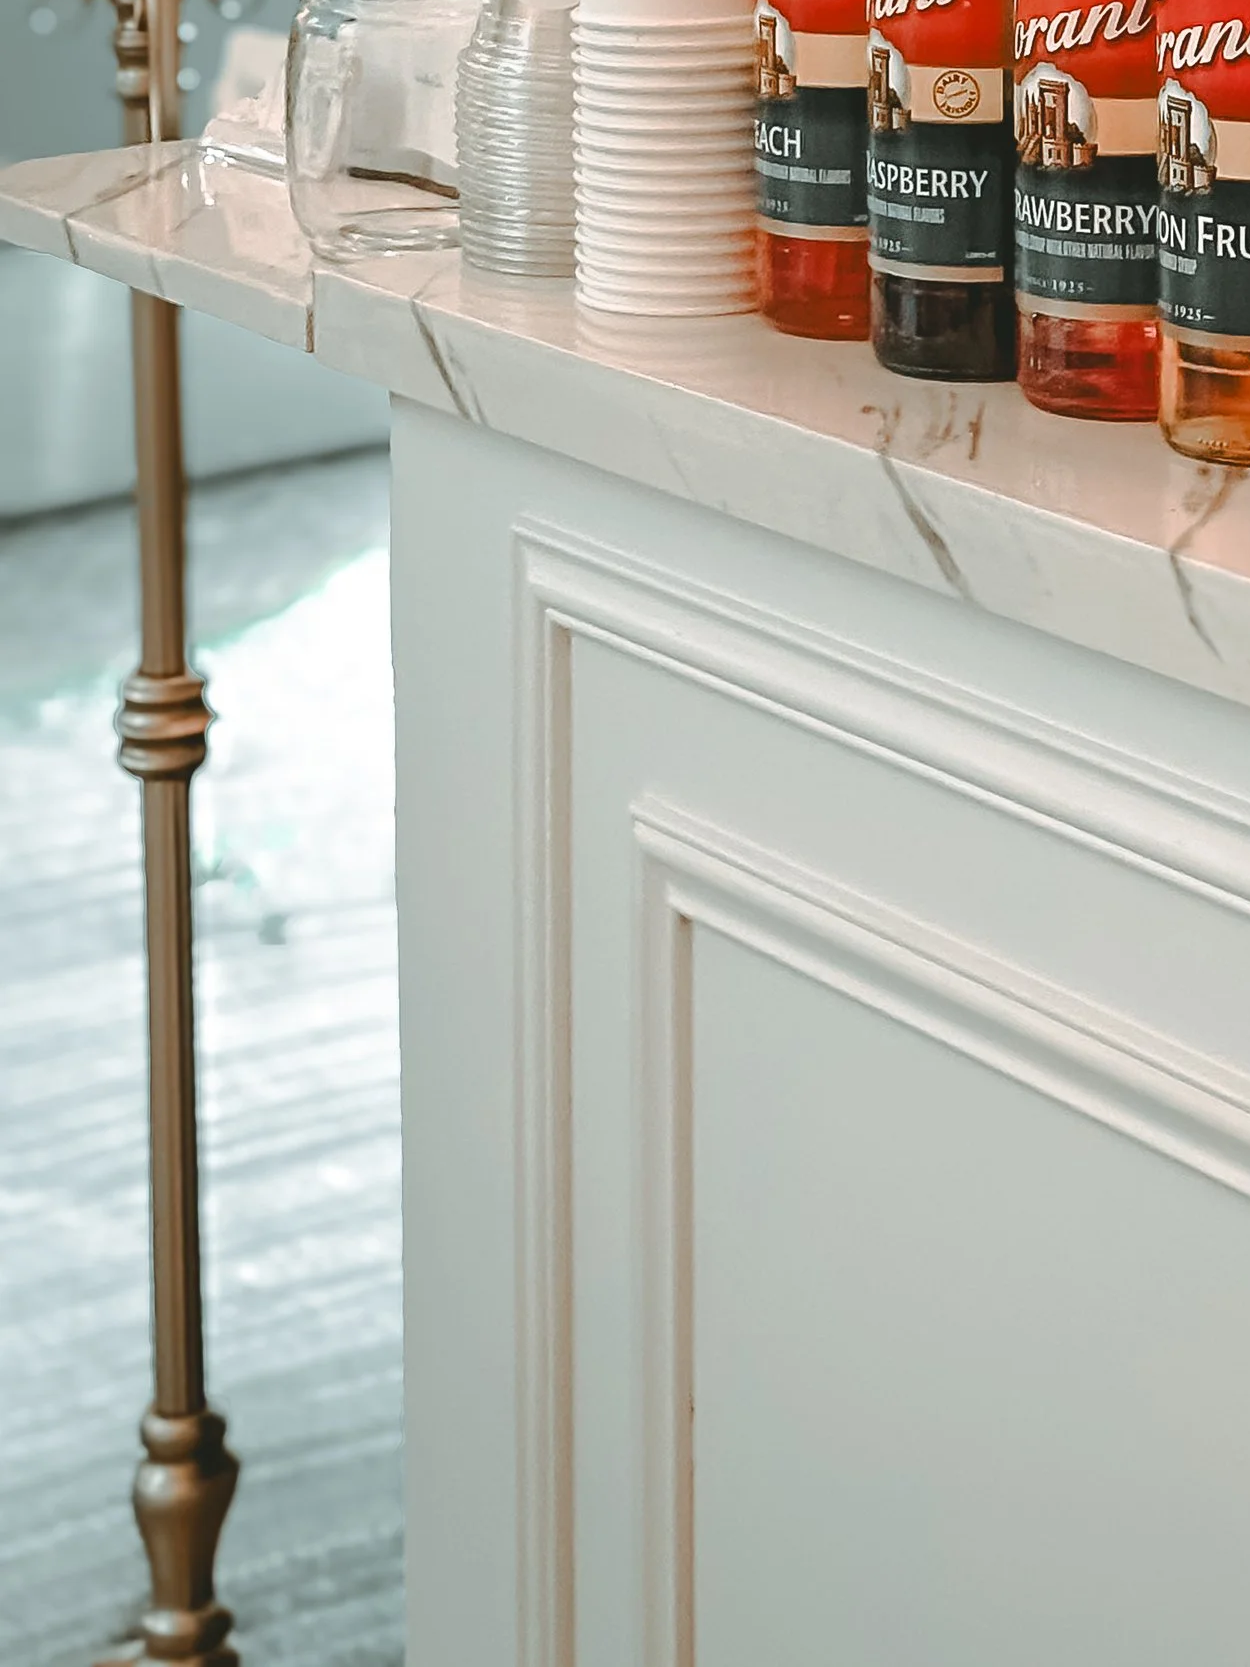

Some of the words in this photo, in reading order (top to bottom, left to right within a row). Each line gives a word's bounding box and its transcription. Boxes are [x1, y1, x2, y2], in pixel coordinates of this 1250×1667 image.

[754, 119, 801, 159] EACH
[1014, 187, 1156, 235] RAWBERRY
[1174, 304, 1202, 322] 1925
